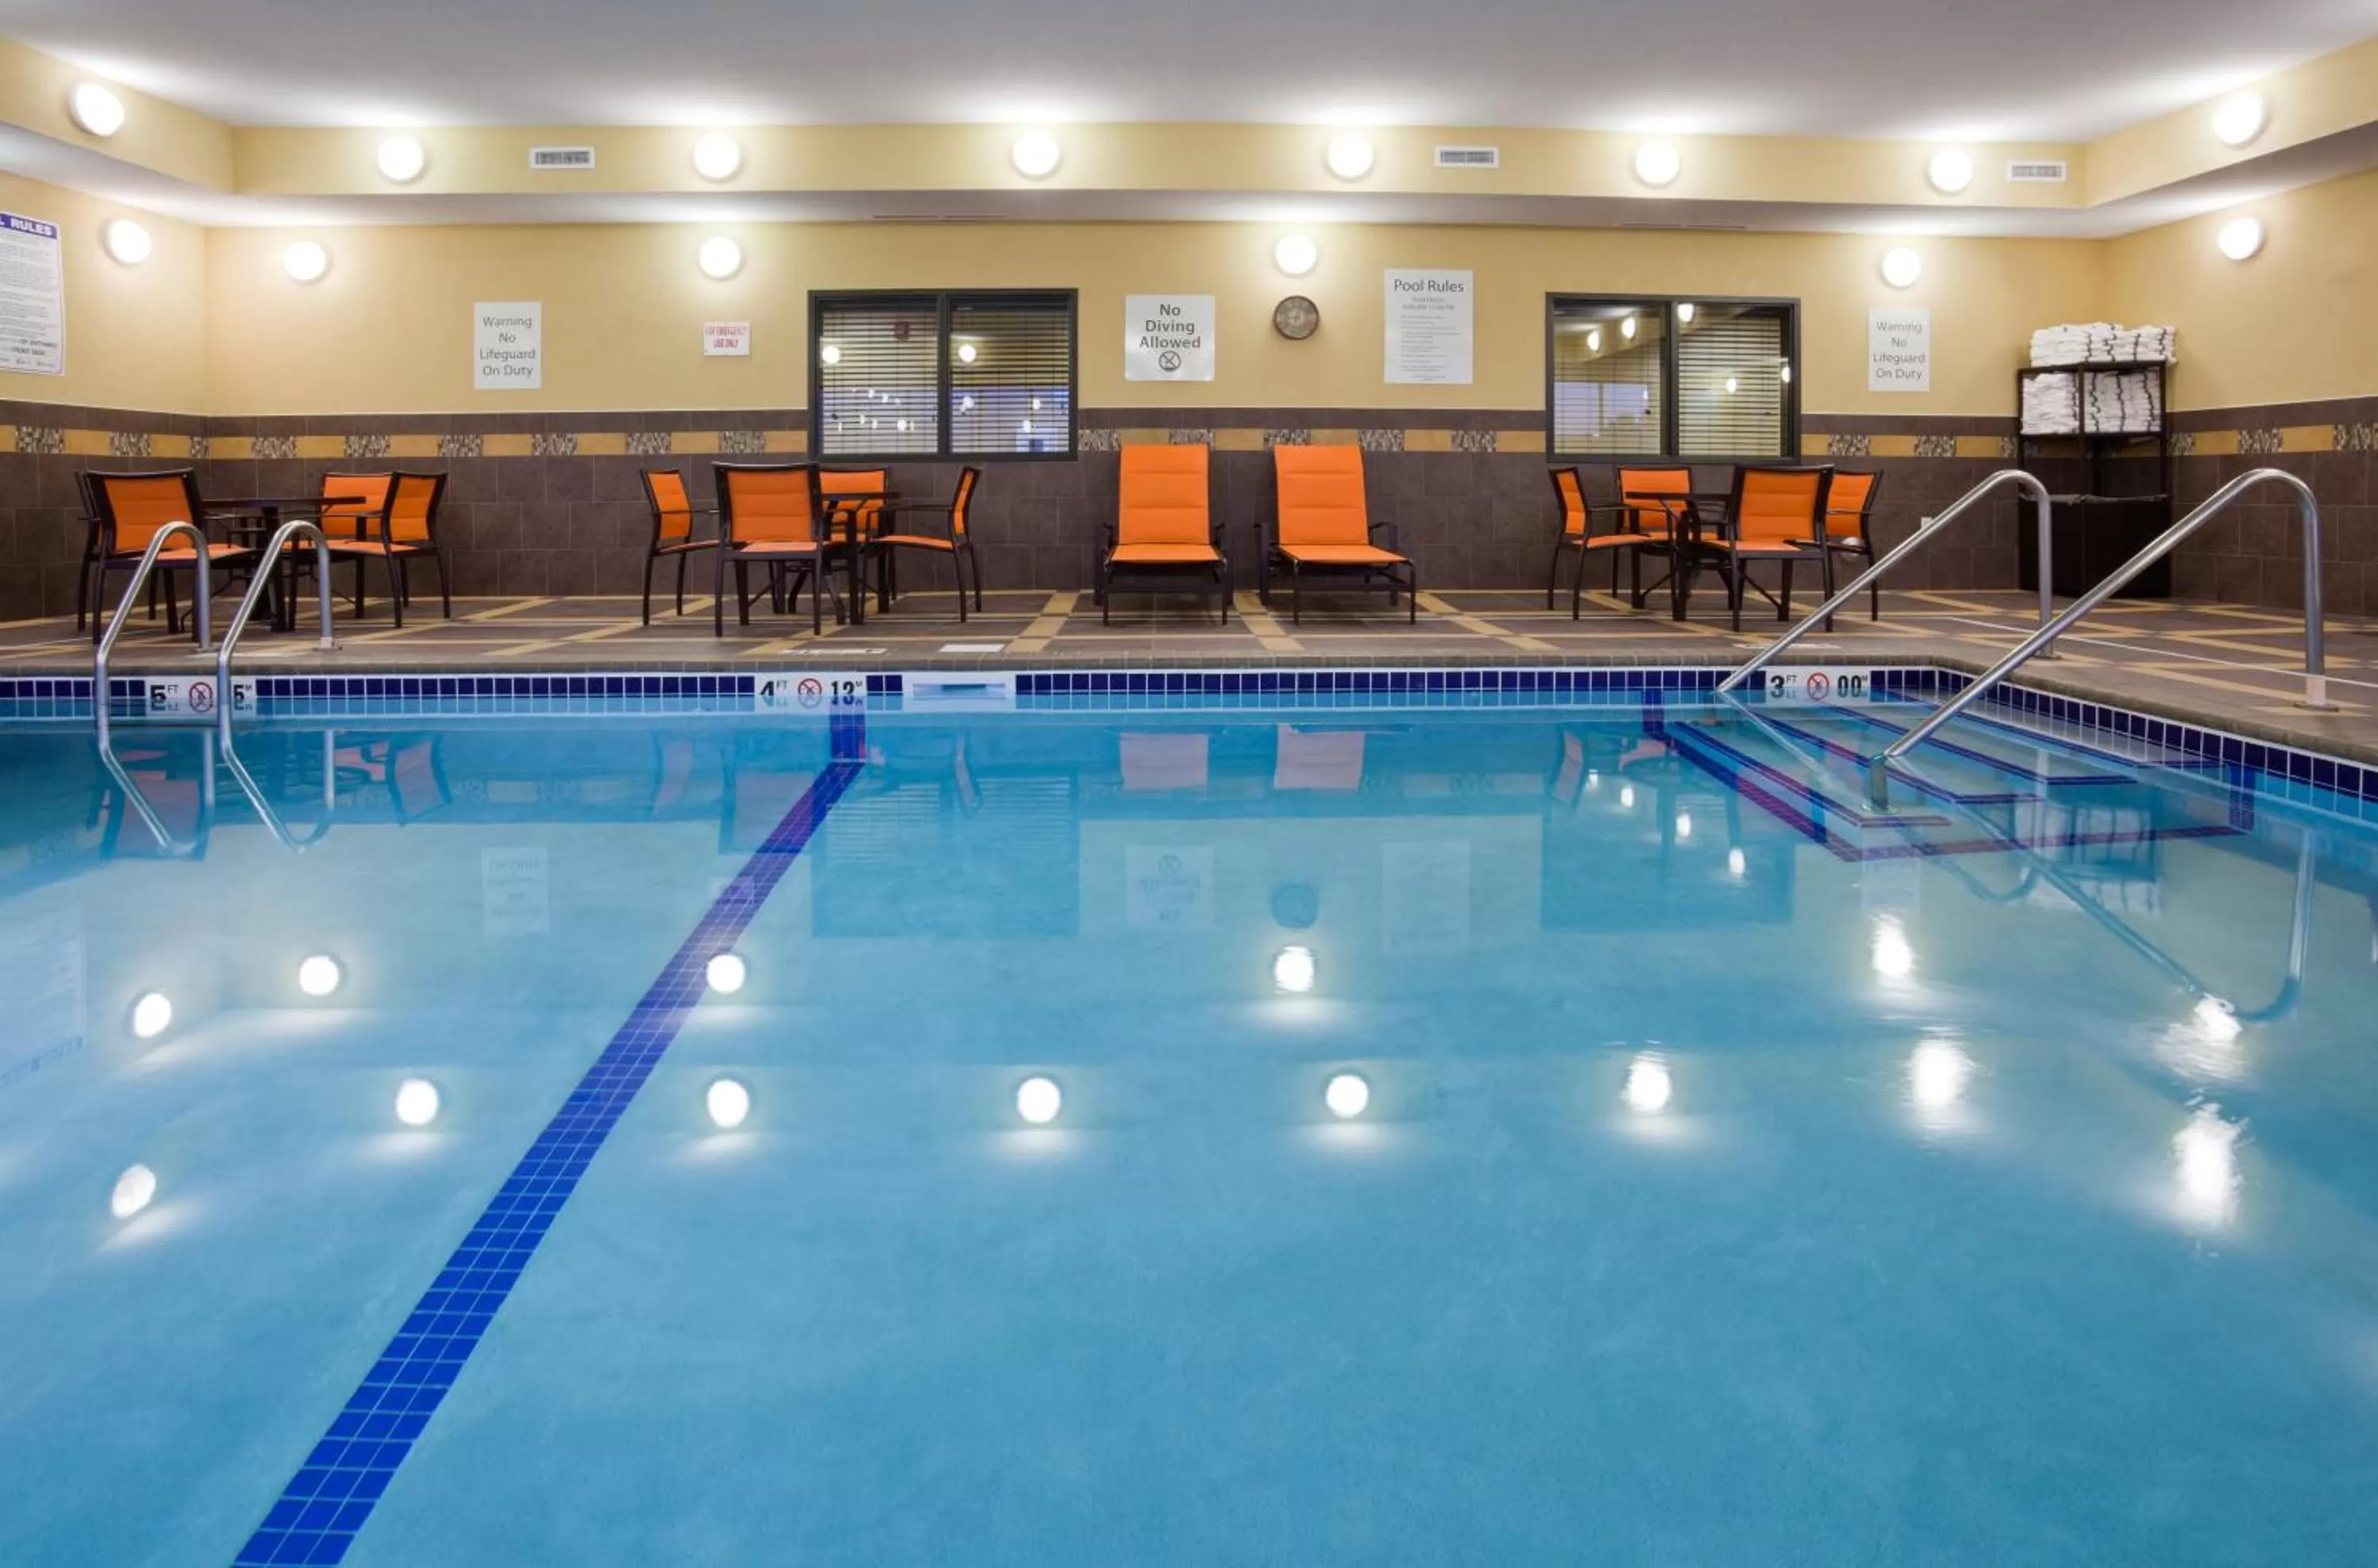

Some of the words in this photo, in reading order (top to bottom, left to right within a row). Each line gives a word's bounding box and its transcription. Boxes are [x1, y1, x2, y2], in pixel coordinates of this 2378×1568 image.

[10, 218, 52, 236] RULES
[1394, 278, 1424, 293] Pool
[1428, 278, 1465, 293] Rules
[1160, 304, 1181, 316] No
[481, 316, 532, 328] Warning
[1145, 319, 1195, 335] Diving
[1876, 321, 1922, 334] Warning
[499, 332, 516, 343] No
[1139, 335, 1201, 348] Allowed
[1891, 337, 1909, 347] No
[480, 348, 536, 361] Lifeguard
[1872, 354, 1926, 365] Lifeguard
[482, 365, 501, 376] On
[503, 365, 533, 377] Duty
[1876, 367, 1893, 378] On
[1895, 368, 1922, 381] Duty
